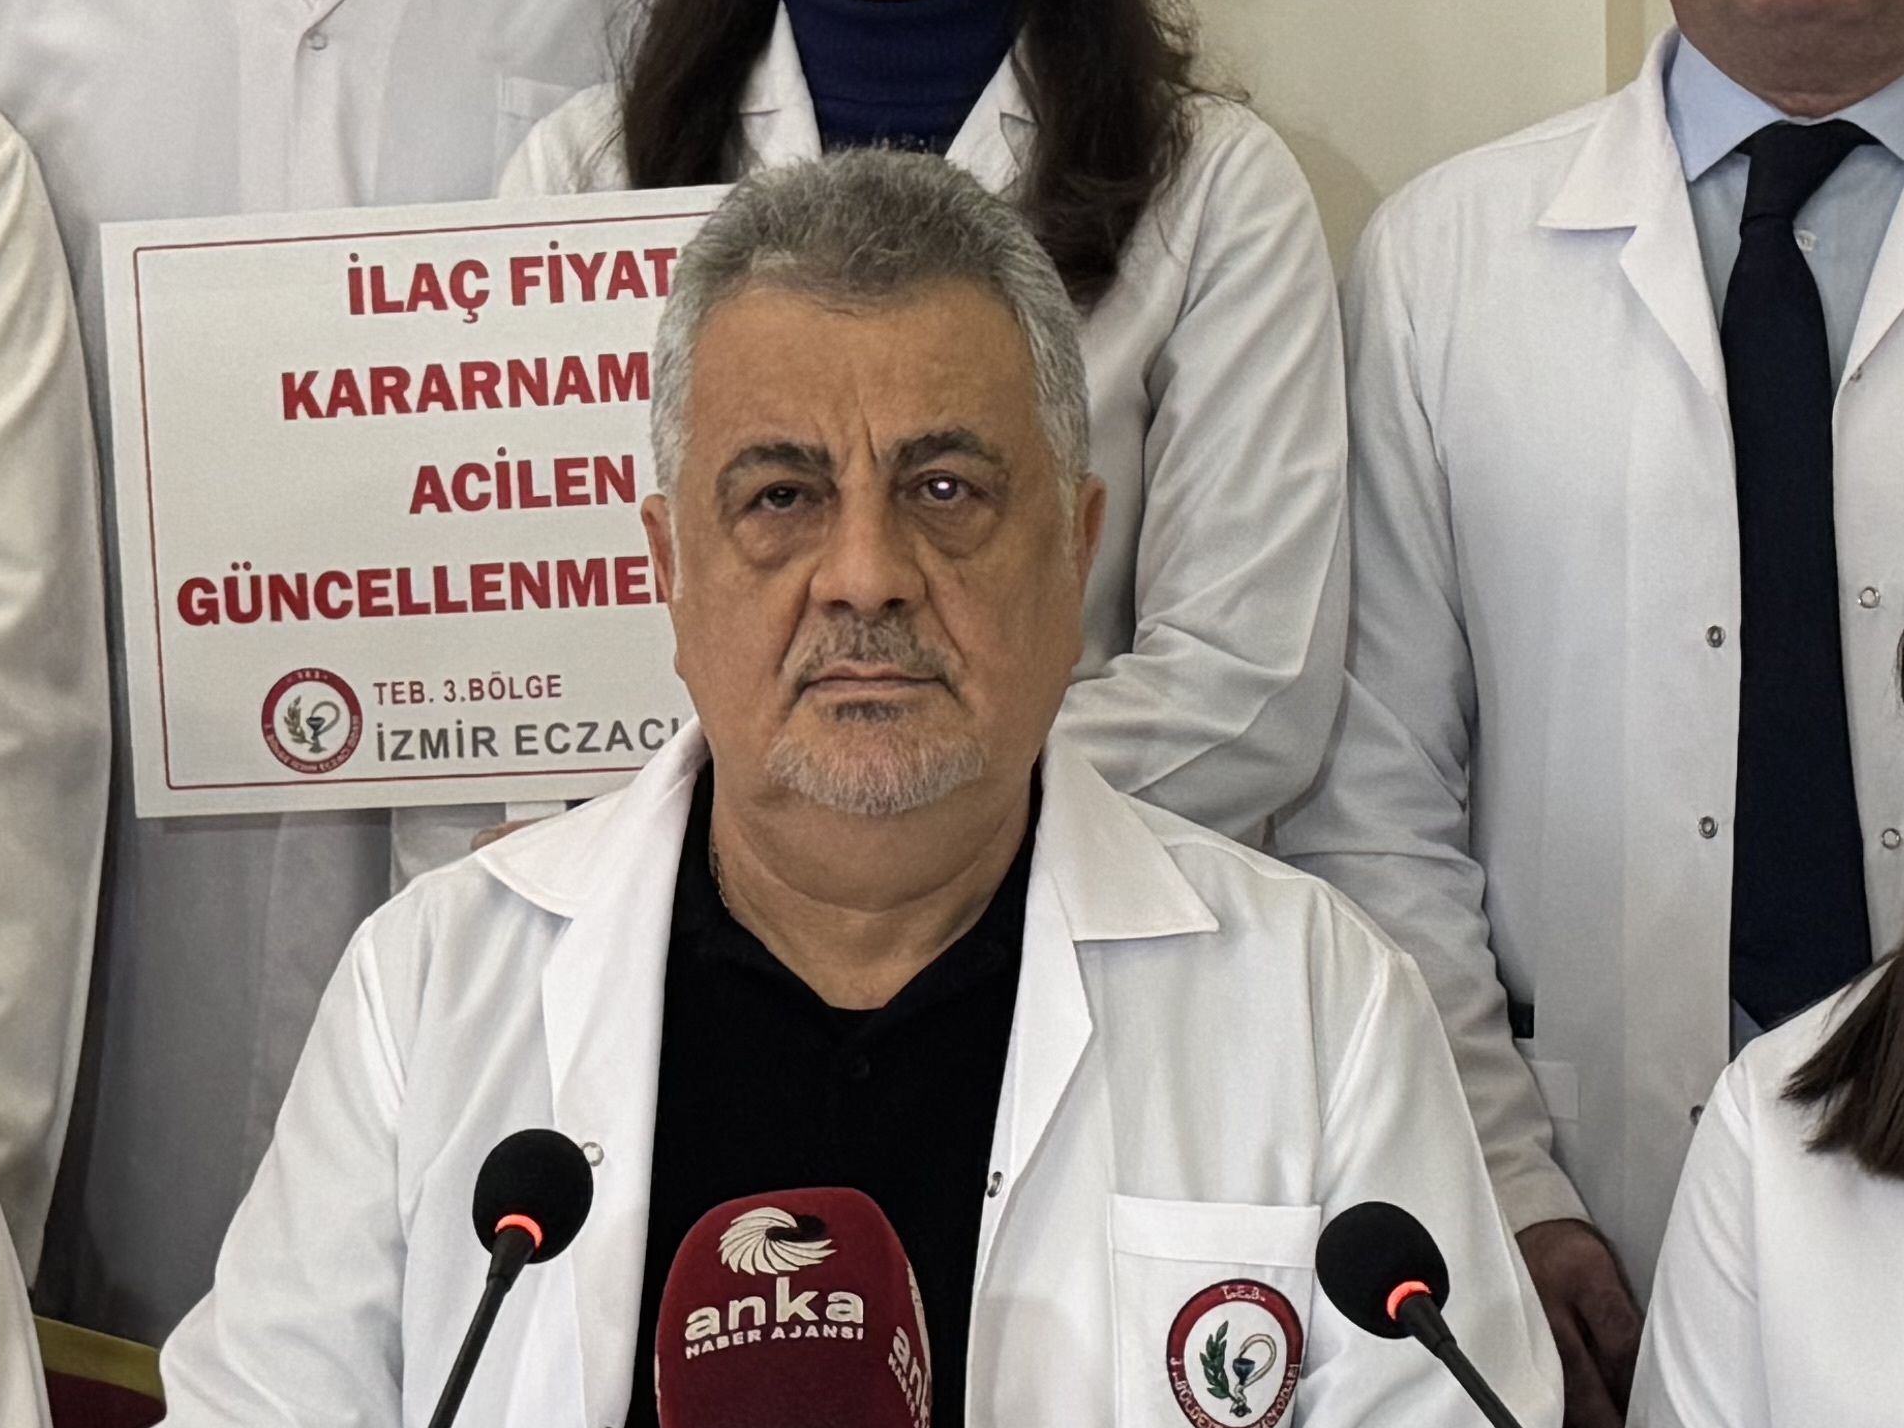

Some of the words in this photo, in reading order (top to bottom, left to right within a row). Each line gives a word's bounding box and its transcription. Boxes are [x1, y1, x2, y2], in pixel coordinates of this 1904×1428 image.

[348, 252, 489, 323] İLAÇ
[510, 240, 678, 306] FİYAT
[409, 446, 636, 515] ACİLEN
[373, 680, 436, 706] TEB.
[377, 719, 499, 762] İZMİR
[684, 1276, 864, 1341] anka
[770, 1324, 864, 1340] AJANSI
